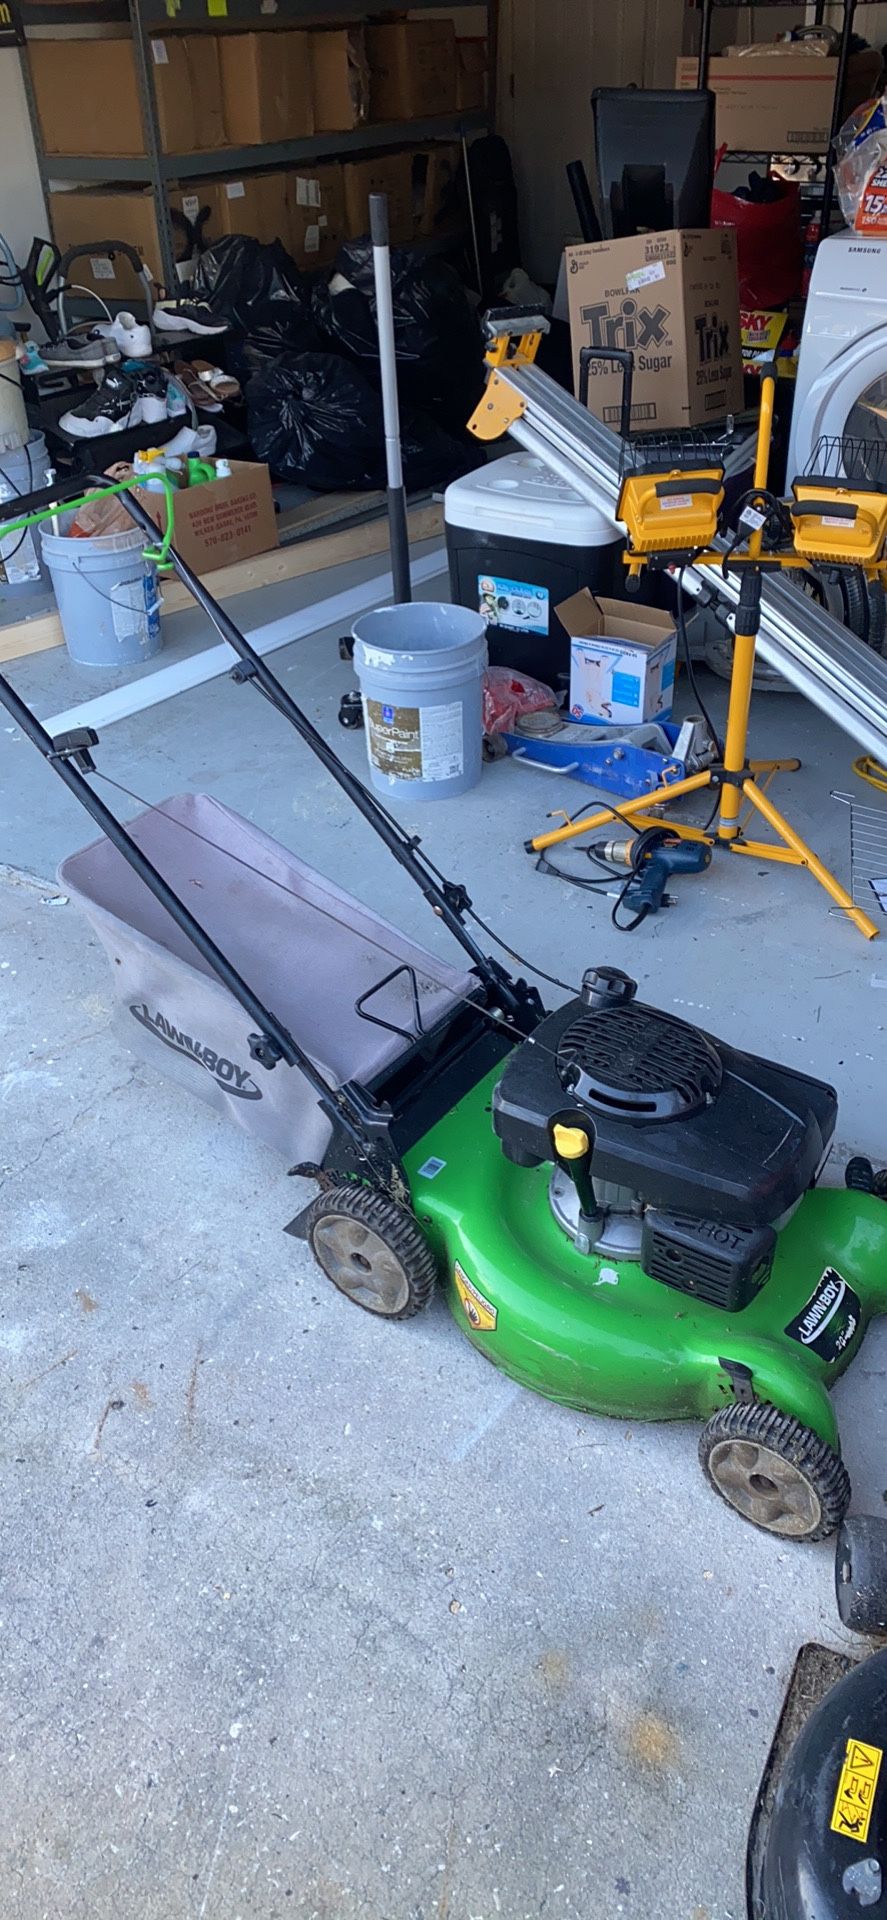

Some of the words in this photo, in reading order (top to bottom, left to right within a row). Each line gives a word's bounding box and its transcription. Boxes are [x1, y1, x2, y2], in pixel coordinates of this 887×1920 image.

[580, 298, 671, 350] Trix
[587, 361, 609, 376] 5%
[611, 358, 637, 374] Le
[638, 355, 673, 373] Sugar
[368, 716, 420, 740] uperPaint
[698, 1221, 745, 1249] HOT
